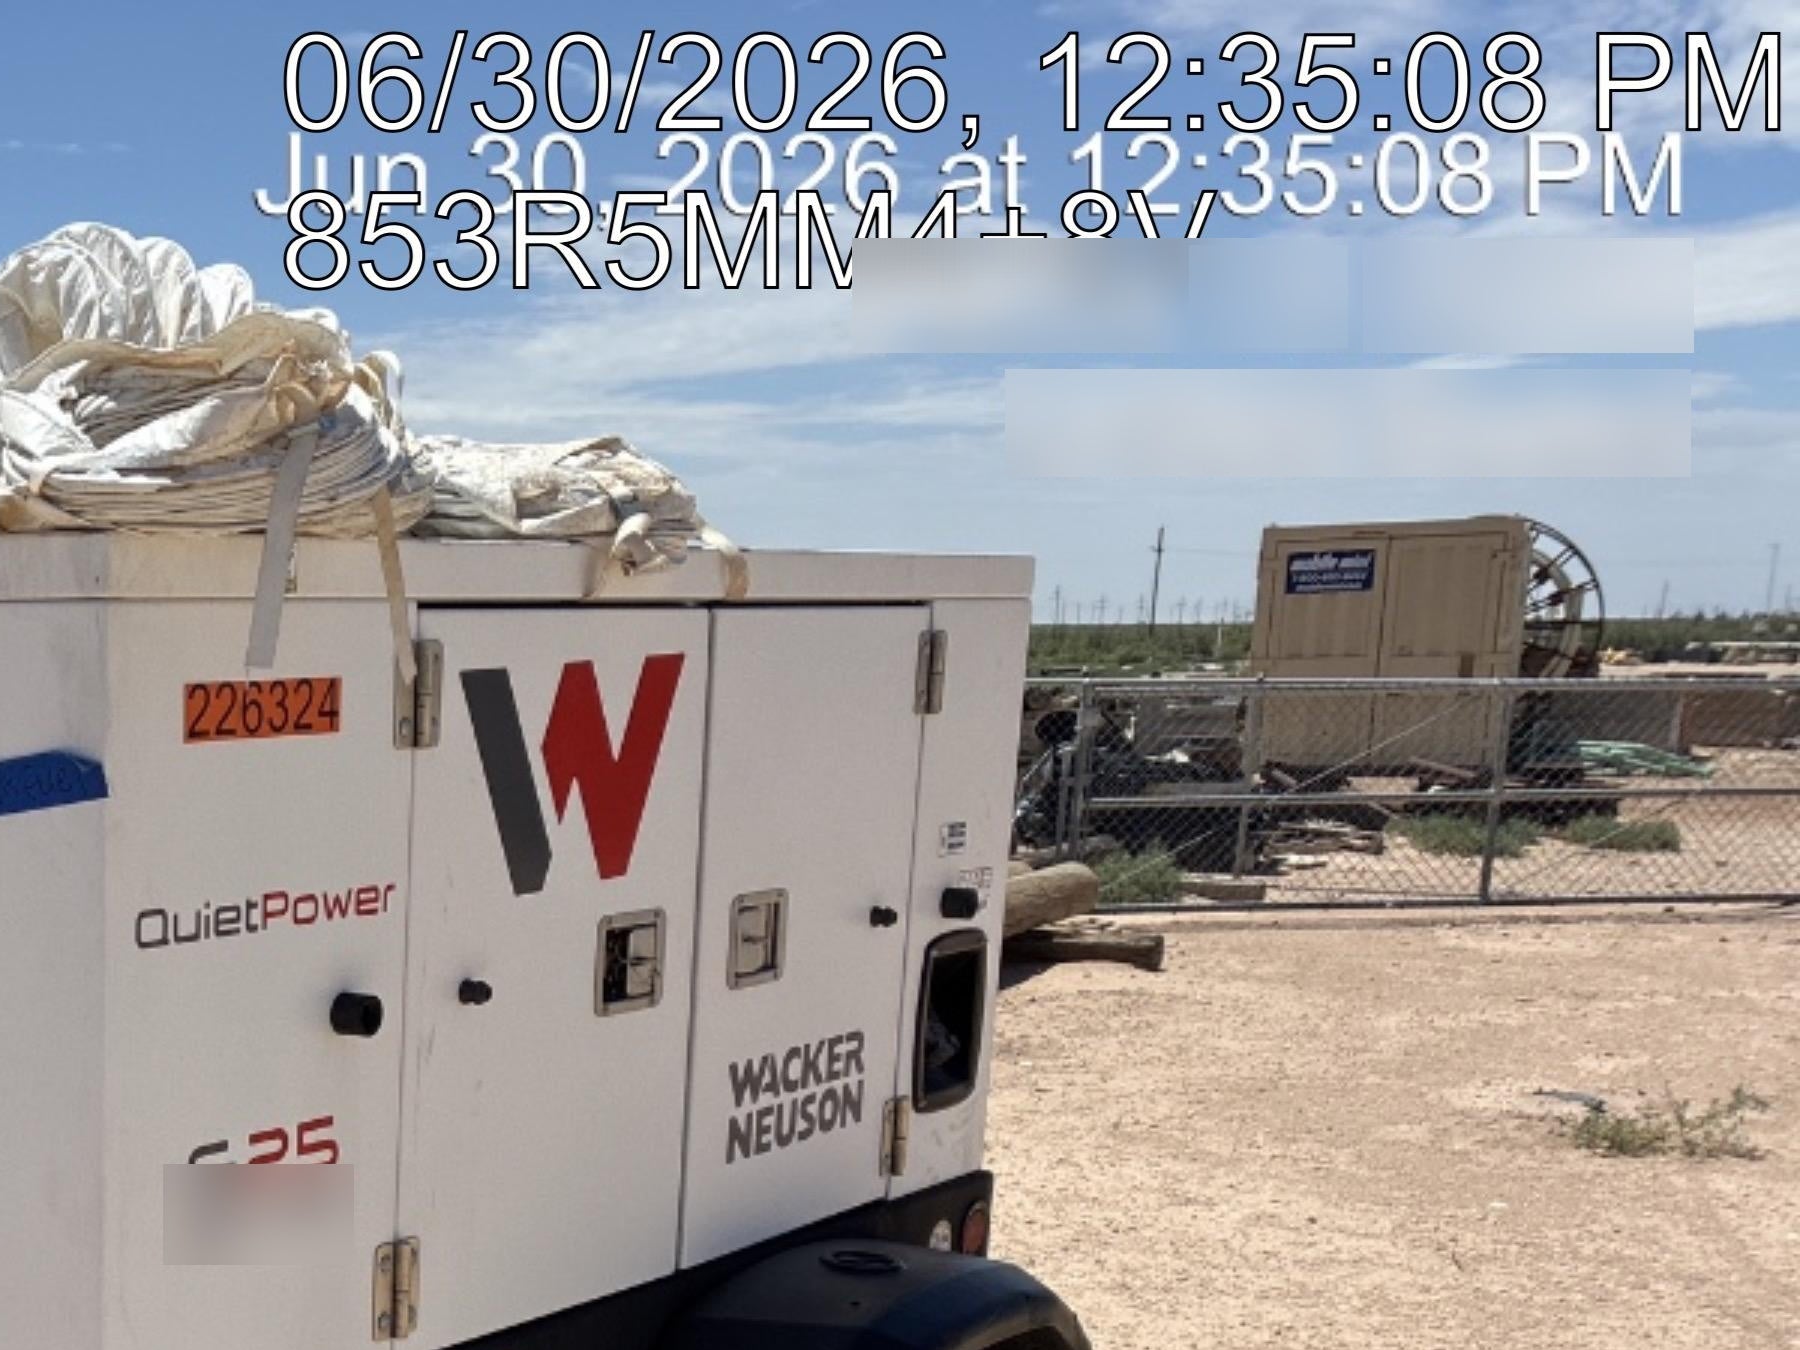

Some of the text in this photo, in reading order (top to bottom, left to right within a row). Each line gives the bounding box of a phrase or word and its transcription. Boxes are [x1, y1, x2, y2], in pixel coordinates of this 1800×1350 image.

[187, 678, 339, 739] 226324
[134, 883, 397, 949] QuietPower
[728, 1029, 866, 1109] WACKER
[724, 1078, 865, 1166] NEUSON
